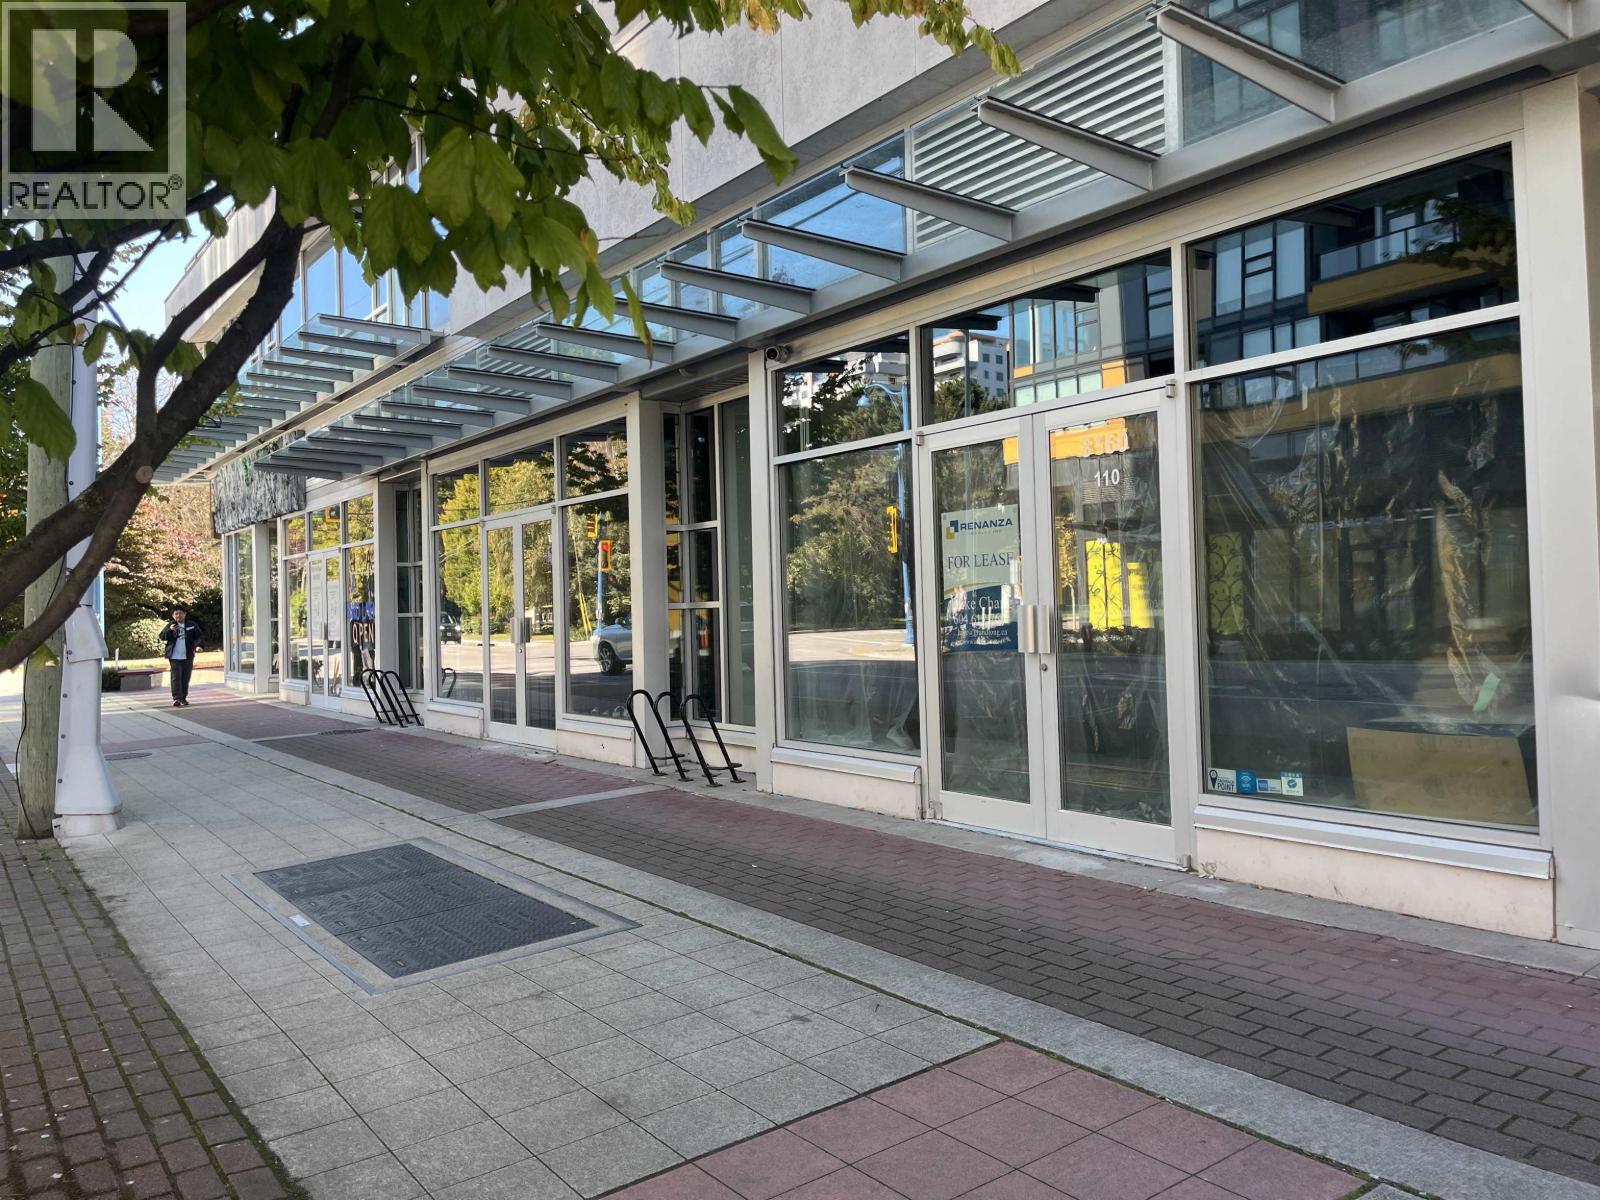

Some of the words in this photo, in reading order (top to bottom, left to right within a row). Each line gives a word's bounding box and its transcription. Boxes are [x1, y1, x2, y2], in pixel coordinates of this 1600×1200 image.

[1094, 468, 1120, 487] 110
[960, 517, 1013, 531] RENANZA
[948, 554, 970, 569] FOR
[974, 551, 1014, 568] LEASE
[352, 622, 374, 645] OPEN
[1217, 783, 1234, 792] POINT
